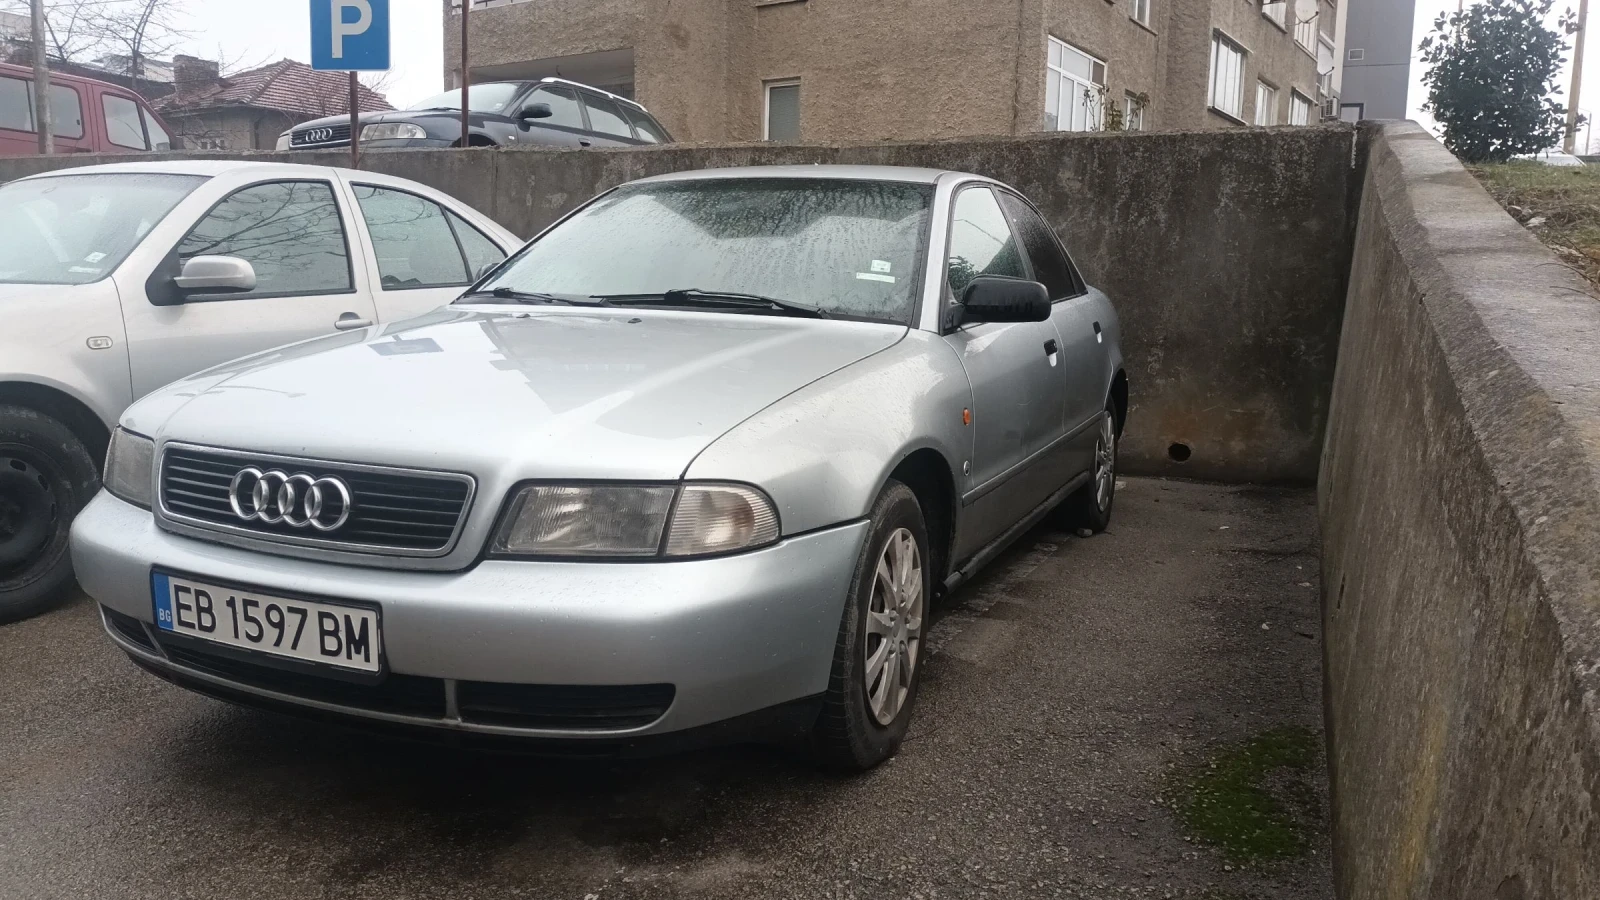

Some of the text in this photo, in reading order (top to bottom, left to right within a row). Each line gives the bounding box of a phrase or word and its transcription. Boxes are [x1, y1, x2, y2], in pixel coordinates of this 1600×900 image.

[331, 0, 372, 58] P
[159, 608, 172, 623] BG
[173, 584, 371, 663] EB 1597 BM
